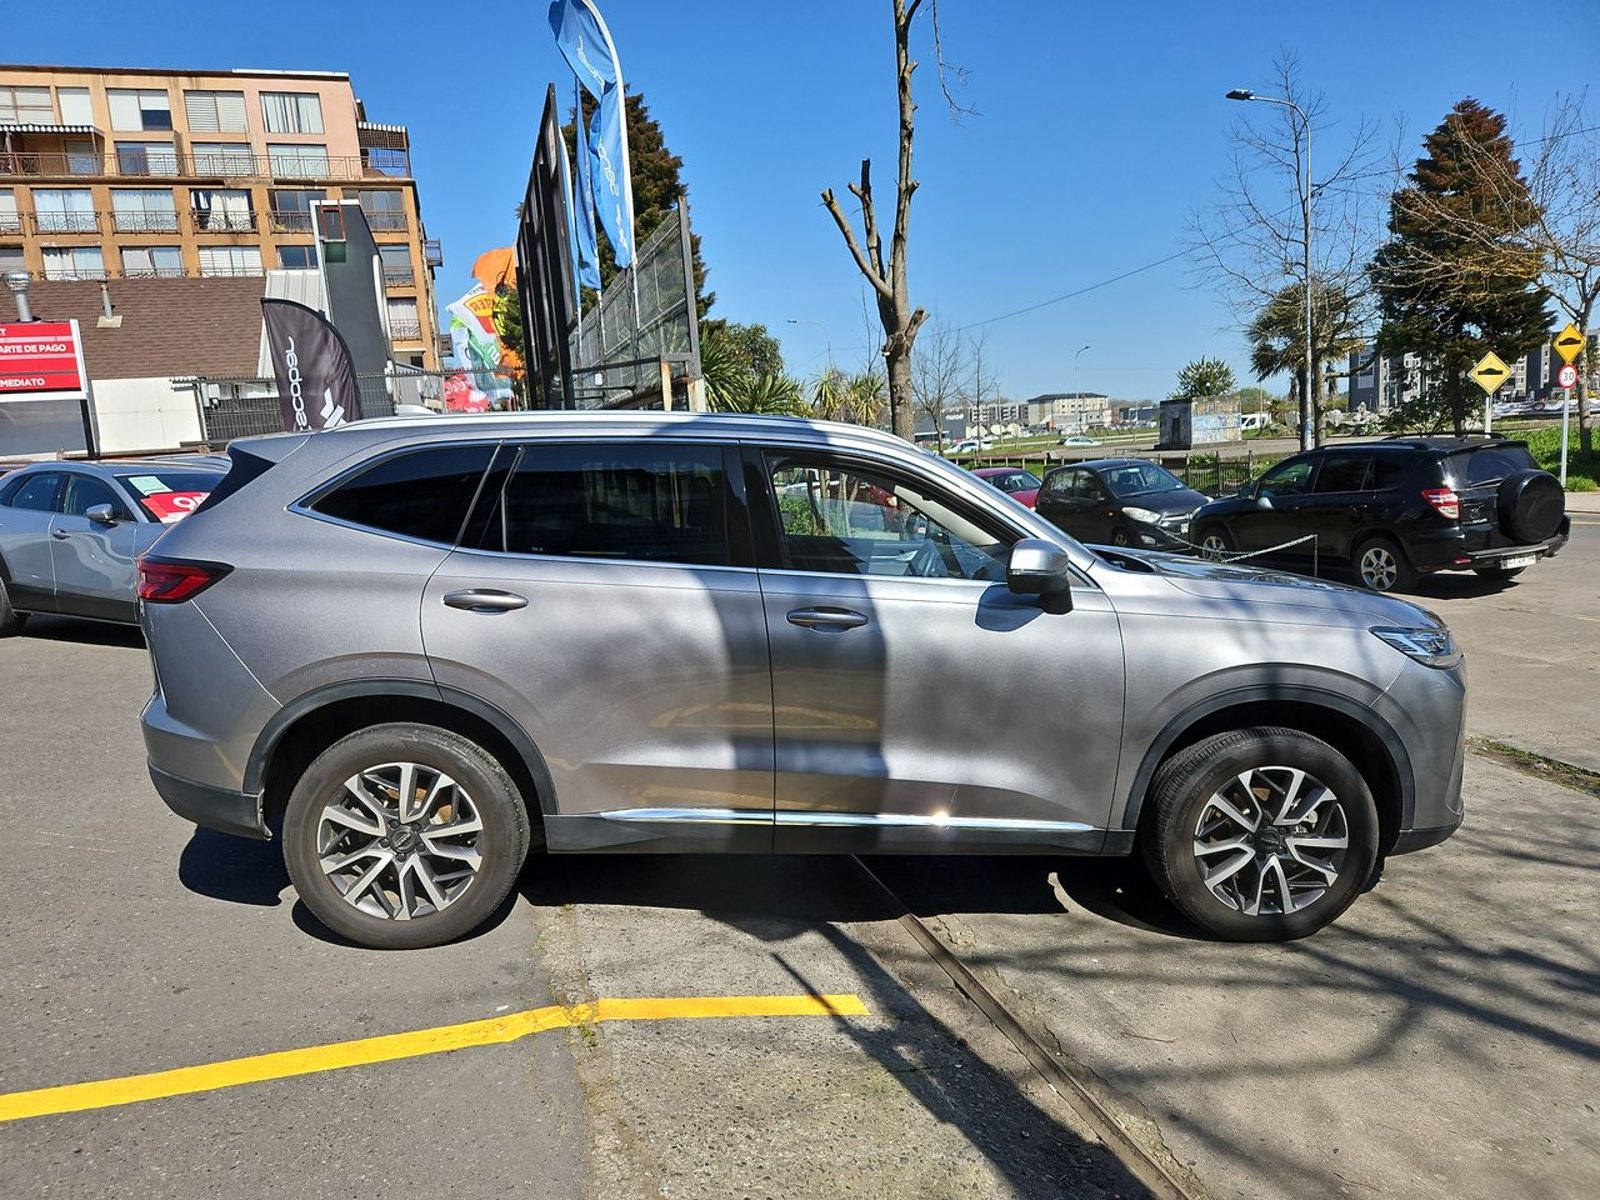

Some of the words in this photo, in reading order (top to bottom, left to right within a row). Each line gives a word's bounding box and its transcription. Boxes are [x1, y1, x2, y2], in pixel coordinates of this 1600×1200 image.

[24, 345, 37, 353] DE
[38, 344, 66, 352] PAGO
[1564, 371, 1575, 382] 30
